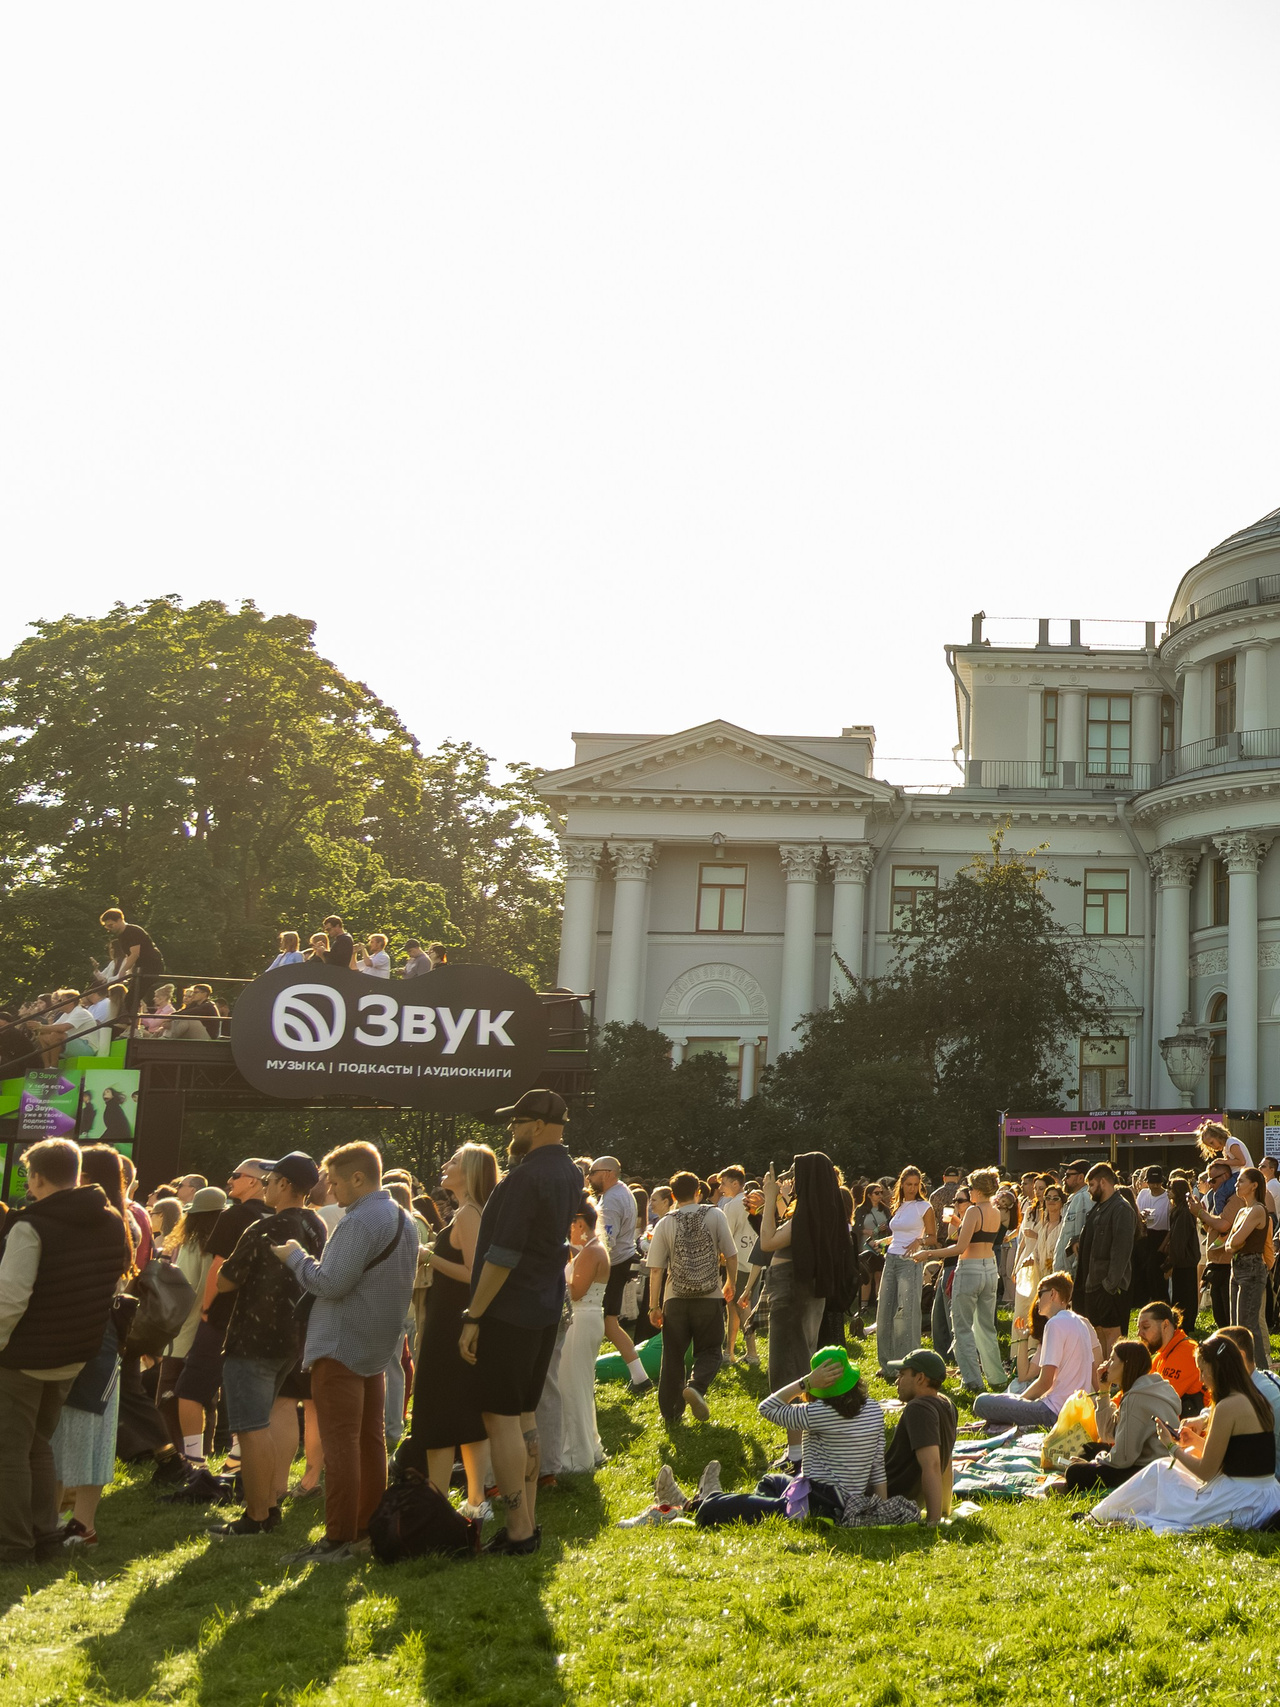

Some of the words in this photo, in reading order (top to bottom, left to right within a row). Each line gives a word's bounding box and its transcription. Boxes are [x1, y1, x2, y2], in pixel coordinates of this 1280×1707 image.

[355, 994, 515, 1054] Звук
[266, 1060, 326, 1071] МУЗЫКА
[338, 1062, 413, 1075] ПОДКАСТЫ
[424, 1066, 512, 1078] АУДИОКНИГИ
[1070, 1120, 1105, 1131] ETLON
[1113, 1119, 1156, 1130] COFFEE
